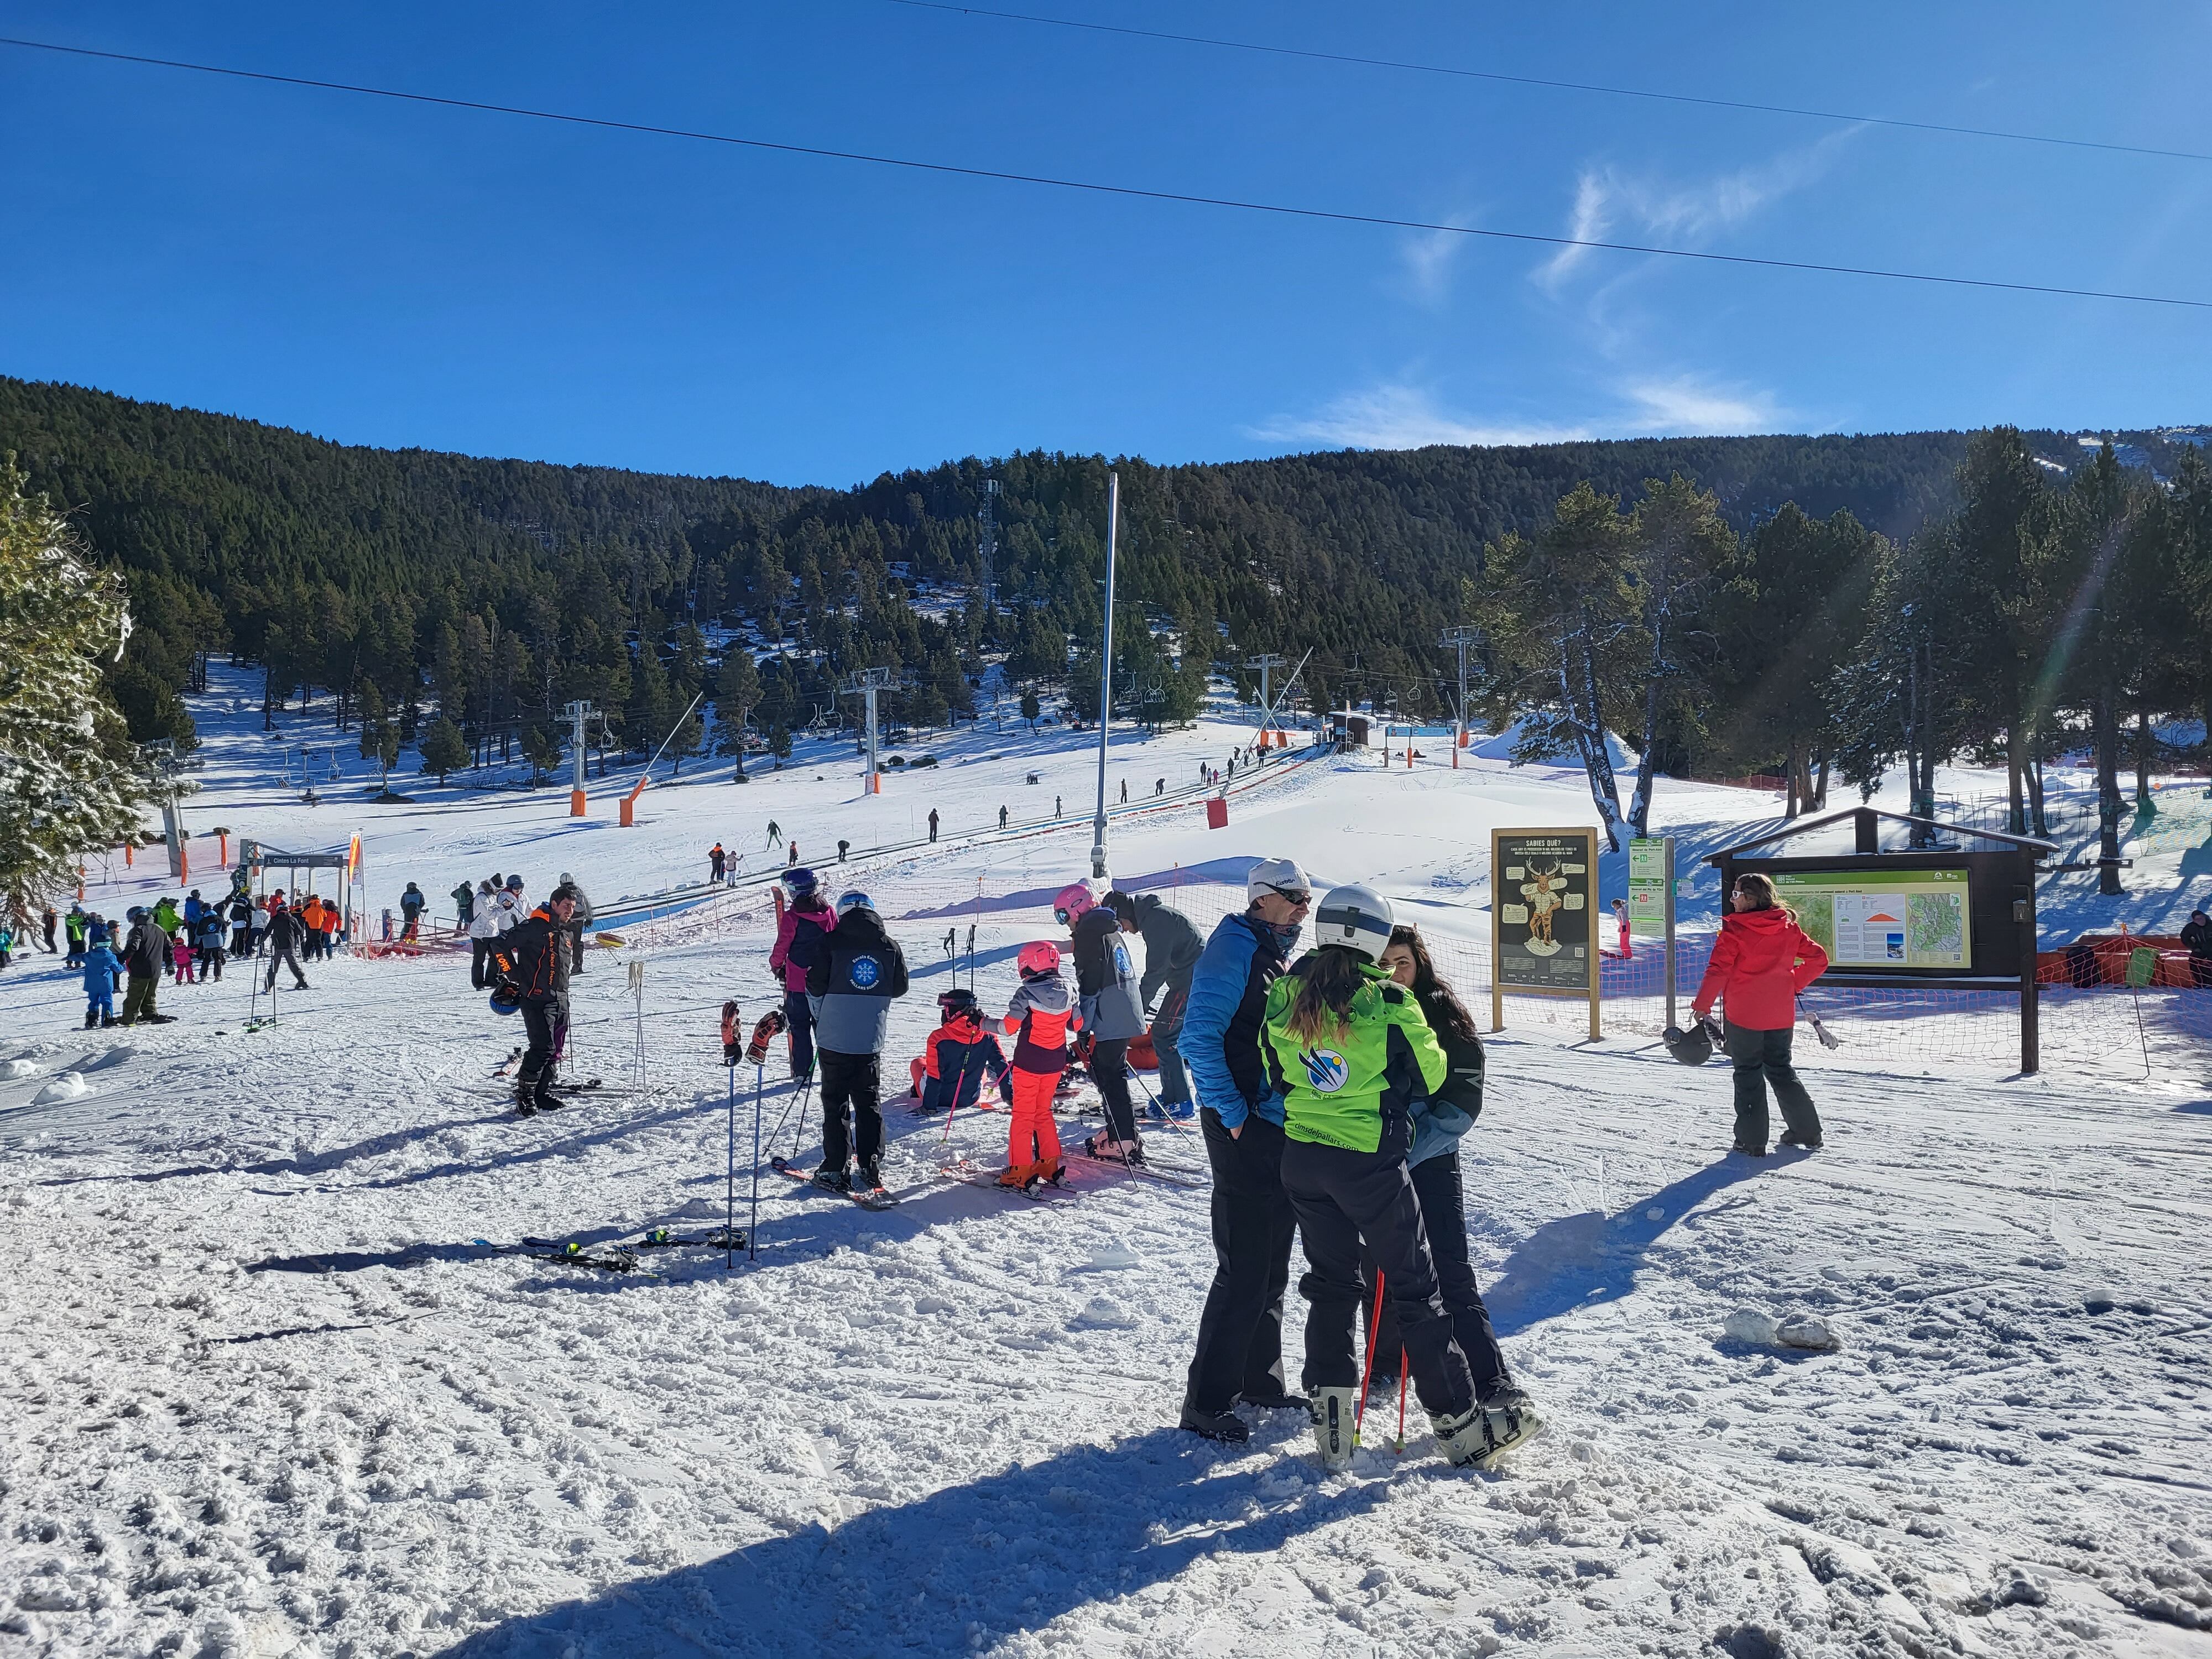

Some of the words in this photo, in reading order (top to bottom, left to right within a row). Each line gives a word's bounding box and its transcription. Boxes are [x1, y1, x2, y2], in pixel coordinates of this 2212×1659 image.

[852, 954, 867, 963] Escola
[849, 978, 866, 990] PALLARS
[1294, 1122, 1359, 1151] cimsdelpallars.com
[1453, 1428, 1522, 1468] HEAD
